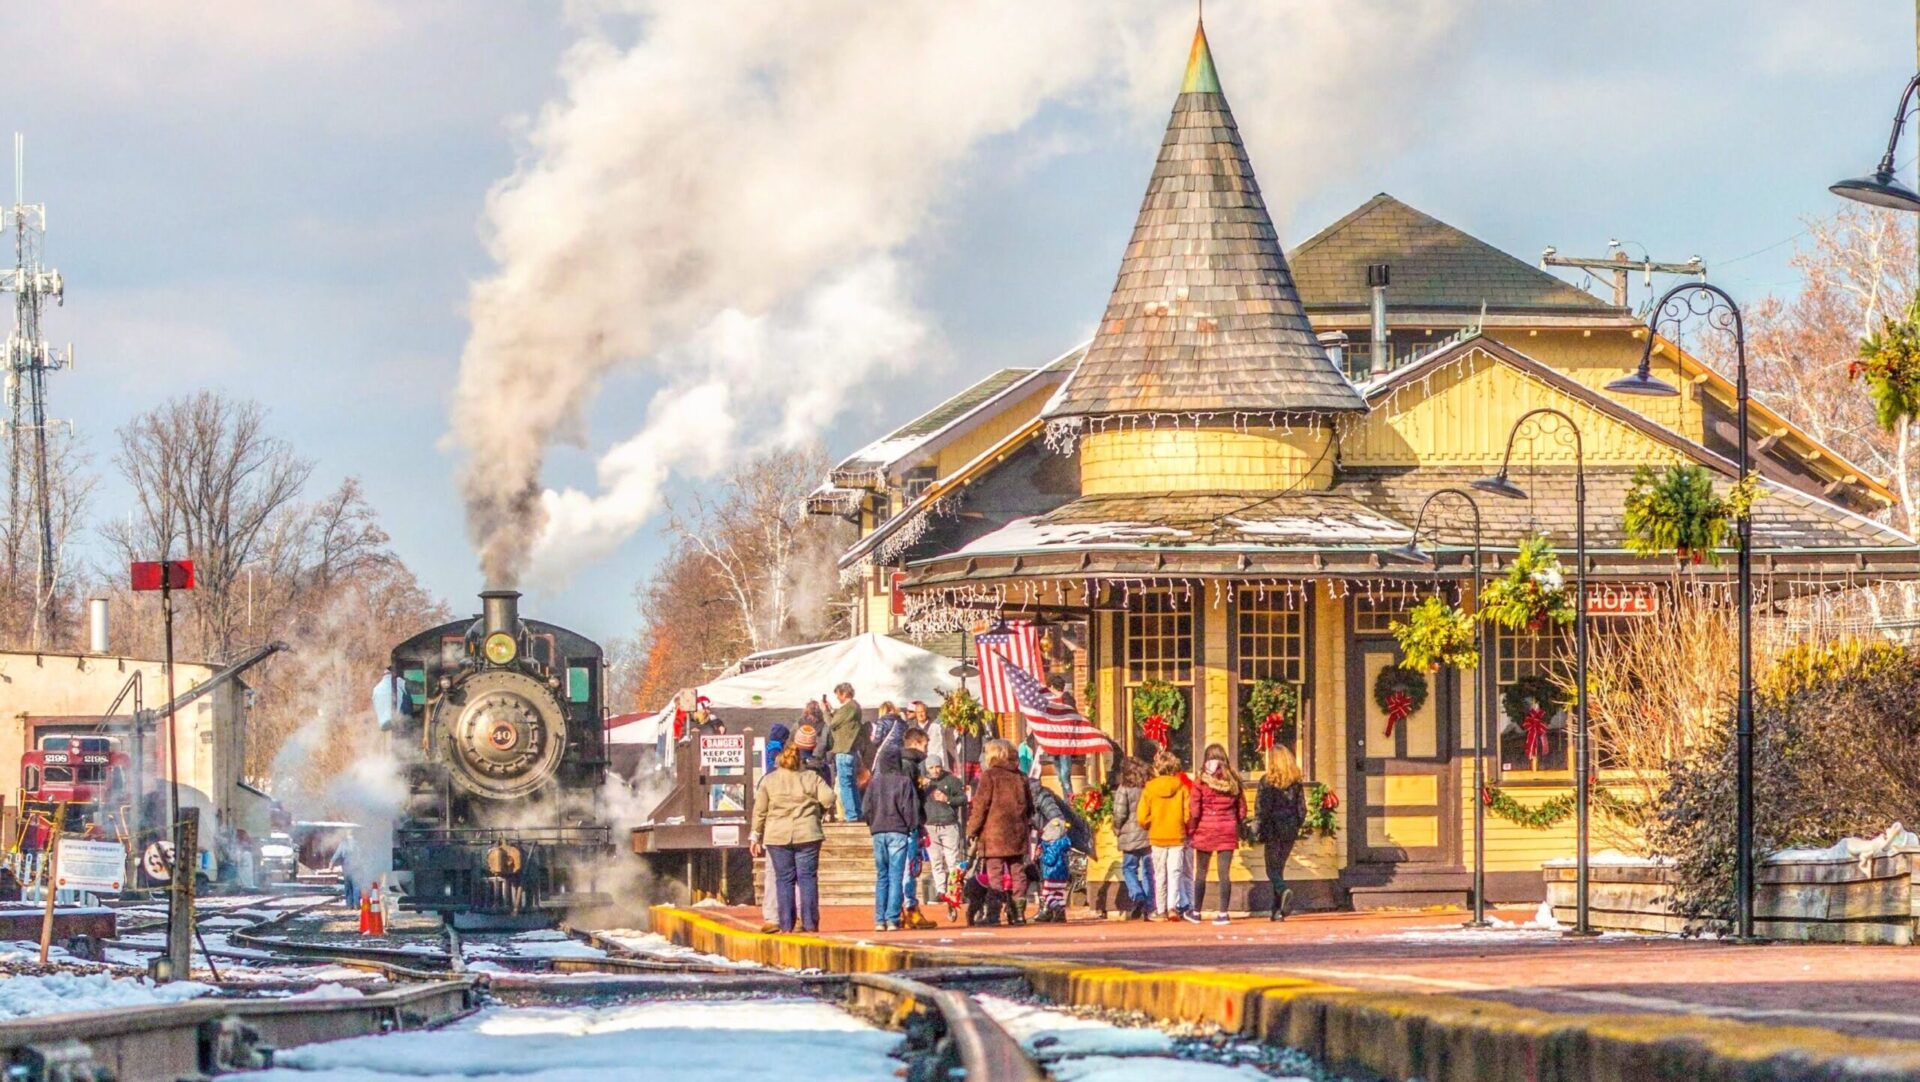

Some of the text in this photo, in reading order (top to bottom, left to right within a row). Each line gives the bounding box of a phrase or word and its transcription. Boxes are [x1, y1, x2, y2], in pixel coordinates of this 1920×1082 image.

[1587, 590, 1648, 610] HOPE
[493, 730, 511, 741] 40
[706, 738, 738, 748] DANGER
